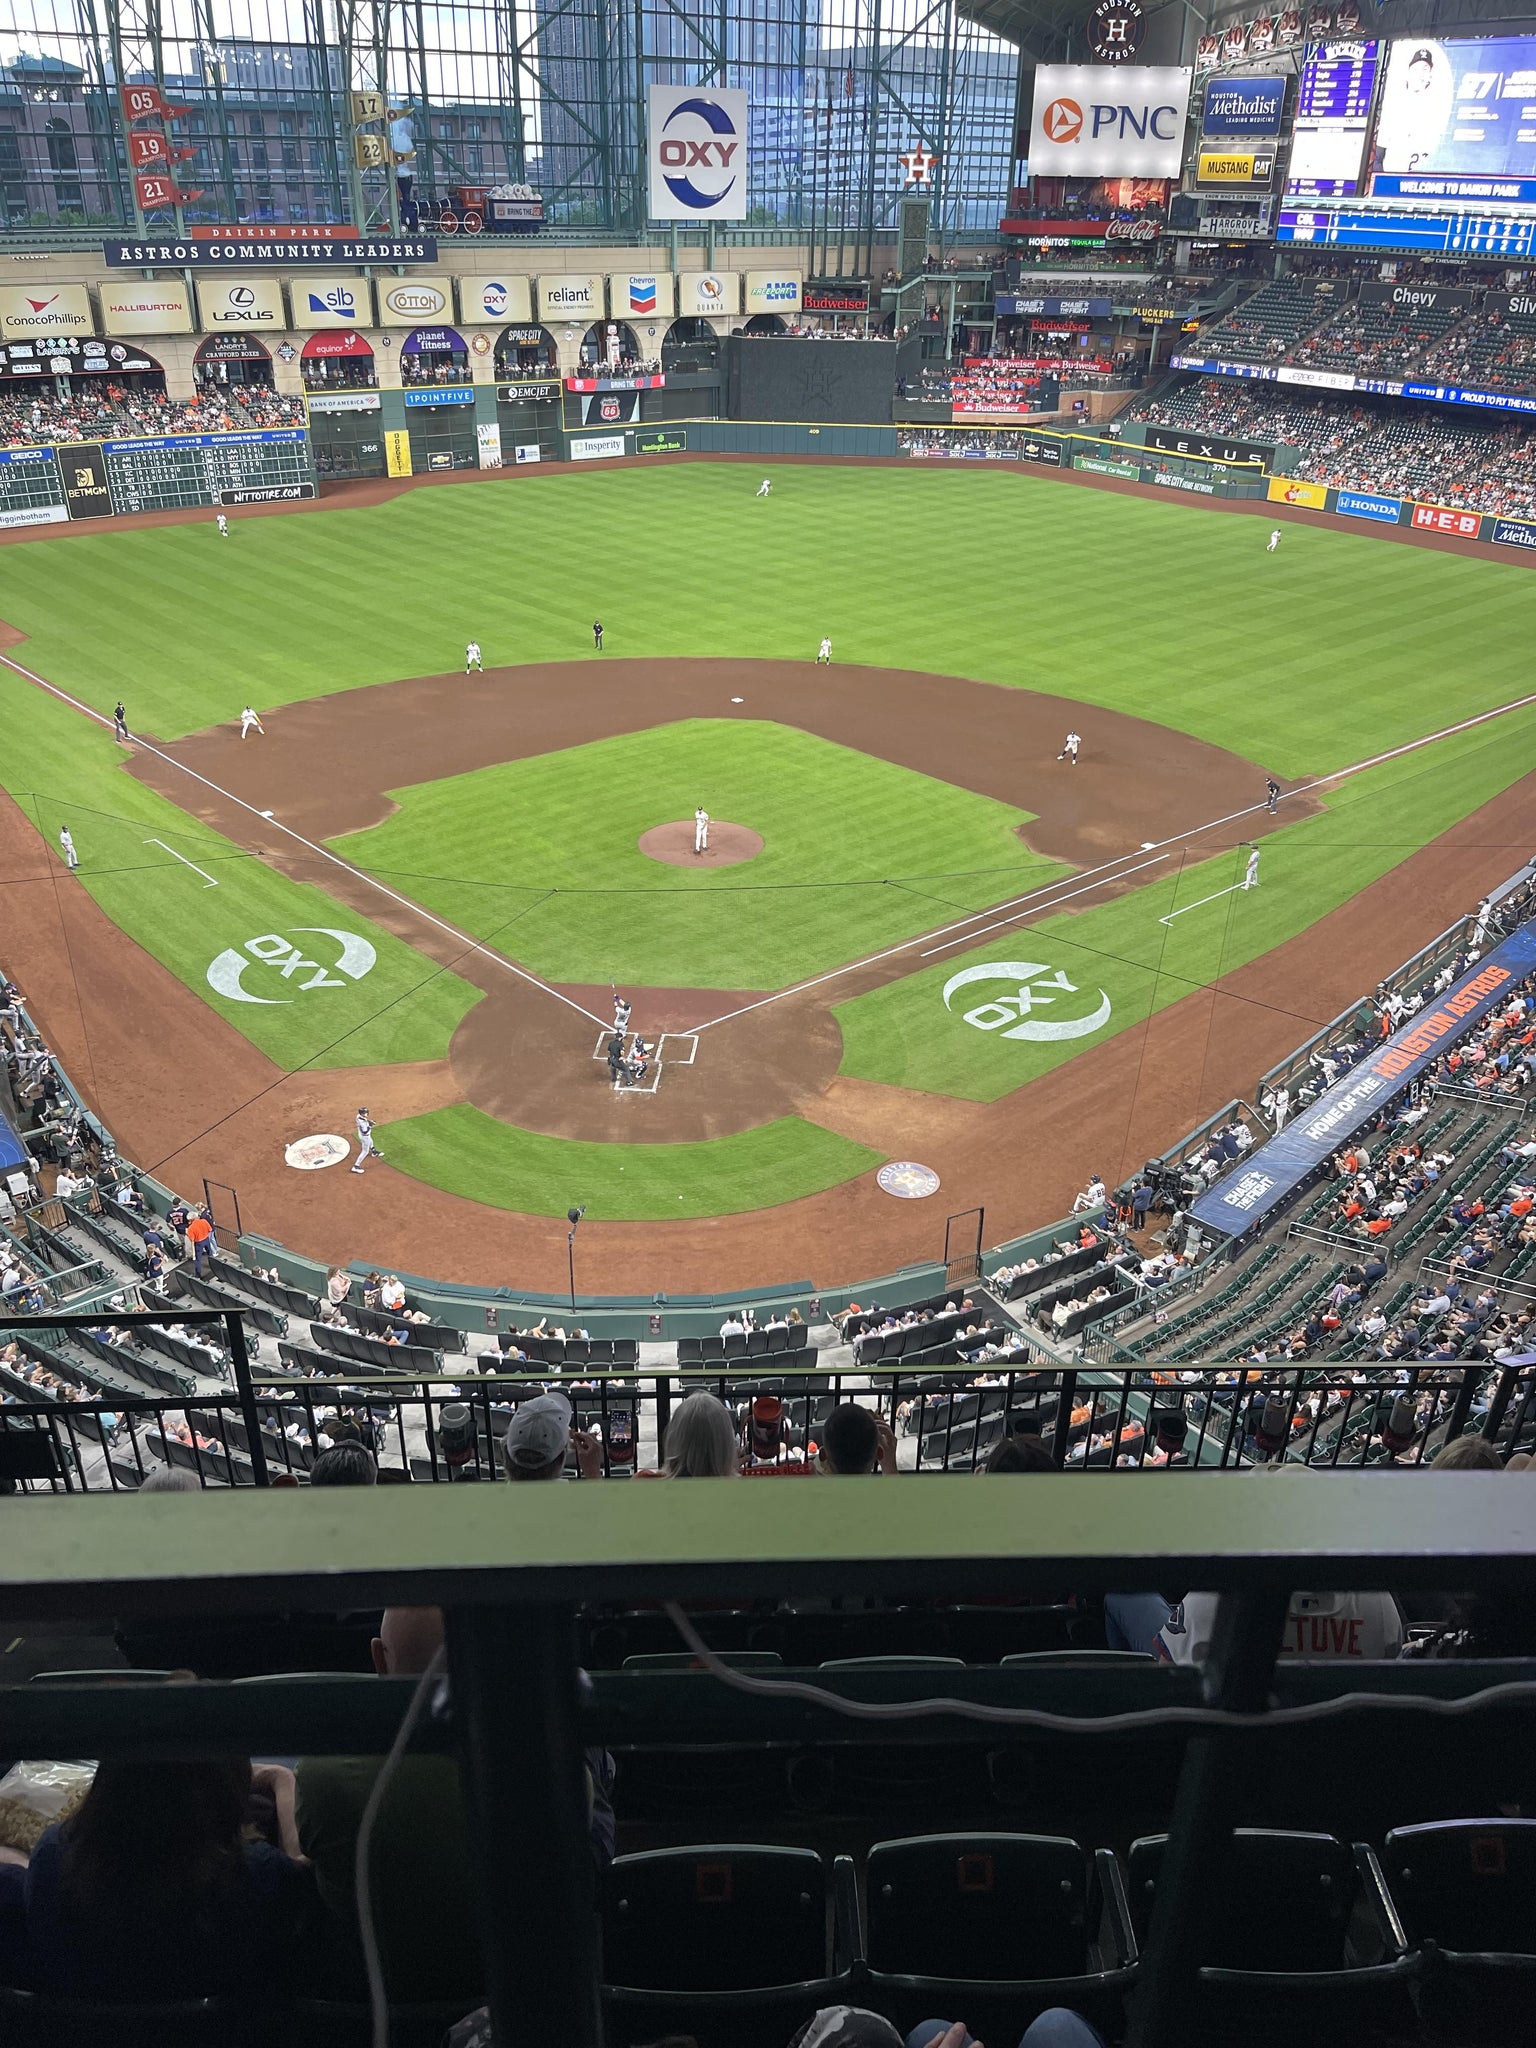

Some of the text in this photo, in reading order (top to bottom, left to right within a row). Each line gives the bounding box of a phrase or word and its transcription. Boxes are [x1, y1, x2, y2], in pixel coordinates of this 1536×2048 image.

[1096, 0, 1142, 18] HOUSTON
[1252, 17, 1272, 38] 25
[1280, 10, 1299, 31] 33
[1224, 26, 1243, 46] 40
[1095, 44, 1135, 60] ASTROS
[131, 91, 153, 110] 05
[359, 99, 376, 114] 17
[1209, 94, 1276, 116] Methodist
[131, 107, 161, 119] CHAMPIONS
[1090, 105, 1178, 140] PNC
[139, 139, 159, 156] 19
[363, 144, 380, 158] 22
[659, 140, 738, 168] OXY
[138, 153, 166, 165] CHAMPIONS
[1207, 161, 1271, 175] MUSTANG CAT
[144, 182, 164, 197] 21
[1400, 181, 1445, 194] WELCOME
[1446, 183, 1458, 194] TO
[1493, 185, 1521, 197] PARK
[142, 196, 170, 207] CHAMPIONS
[1297, 213, 1315, 225] COL
[212, 228, 333, 237] DAIKIN PARK
[1210, 219, 1260, 234] HARGROVE
[1293, 228, 1314, 240] HOU
[1029, 237, 1070, 247] HORNITOS
[121, 244, 425, 261] ASTROS COMMUNITY LEADERS
[1064, 263, 1099, 271] HORNITOS
[326, 287, 354, 307] slb
[548, 288, 589, 302] reliant
[751, 281, 797, 300] FREEPORT LNG
[1393, 288, 1436, 307] Chevy
[394, 292, 437, 311] COTTON
[484, 295, 506, 304] OXY
[803, 295, 868, 310] Budweiser
[110, 303, 182, 313] HALLIBURTON
[696, 303, 724, 311] QUANTA
[1132, 308, 1174, 319] PLUCKERS
[6, 313, 87, 327] ConocoPhillips
[212, 310, 274, 321] LEXUS
[1031, 319, 1090, 332] Budweiser
[416, 331, 445, 343] planet
[508, 330, 542, 341] SPACE CITY
[316, 345, 343, 353] equinor
[421, 340, 451, 349] fitness
[991, 360, 1036, 369] Budweiser
[1062, 361, 1100, 371] Budweiser
[1182, 358, 1204, 366] GORDON
[1263, 367, 1271, 379] K
[409, 391, 471, 404] 1POINTFIVE
[518, 386, 550, 398] EMCJET
[1409, 387, 1435, 396] UNITED
[1460, 393, 1485, 403] PROUD
[1486, 394, 1495, 404] TO
[1495, 396, 1507, 406] FLY
[1508, 397, 1521, 408] THE
[604, 406, 616, 416] 66
[975, 403, 1019, 412] Budweiser
[112, 442, 127, 450] GOOD
[361, 445, 378, 453] 366
[394, 432, 402, 472] DOGGETT
[585, 440, 620, 452] Insperity
[642, 444, 667, 452] Huntington
[1155, 437, 1262, 463] LEXUS
[10, 451, 42, 460] GEICO
[1087, 461, 1106, 471] National
[1116, 468, 1131, 476] Rental
[1212, 464, 1226, 472] 370
[1154, 473, 1170, 485] SPACE
[1170, 475, 1184, 487] CITY
[1194, 481, 1214, 494] NETWORK
[68, 486, 107, 498] BETMGM
[234, 487, 301, 503] NITTOTIRE.COM
[1350, 500, 1398, 516] HONDA
[1501, 523, 1526, 531] HOUSTON
[244, 933, 347, 991] OXY
[962, 970, 1080, 1031] OXY
[1371, 964, 1512, 1081] HOUSTON ASTROS
[1305, 1076, 1380, 1141] HOME OF THE
[1223, 1173, 1258, 1205] CHASE
[1234, 1175, 1277, 1210] THE FIGHT
